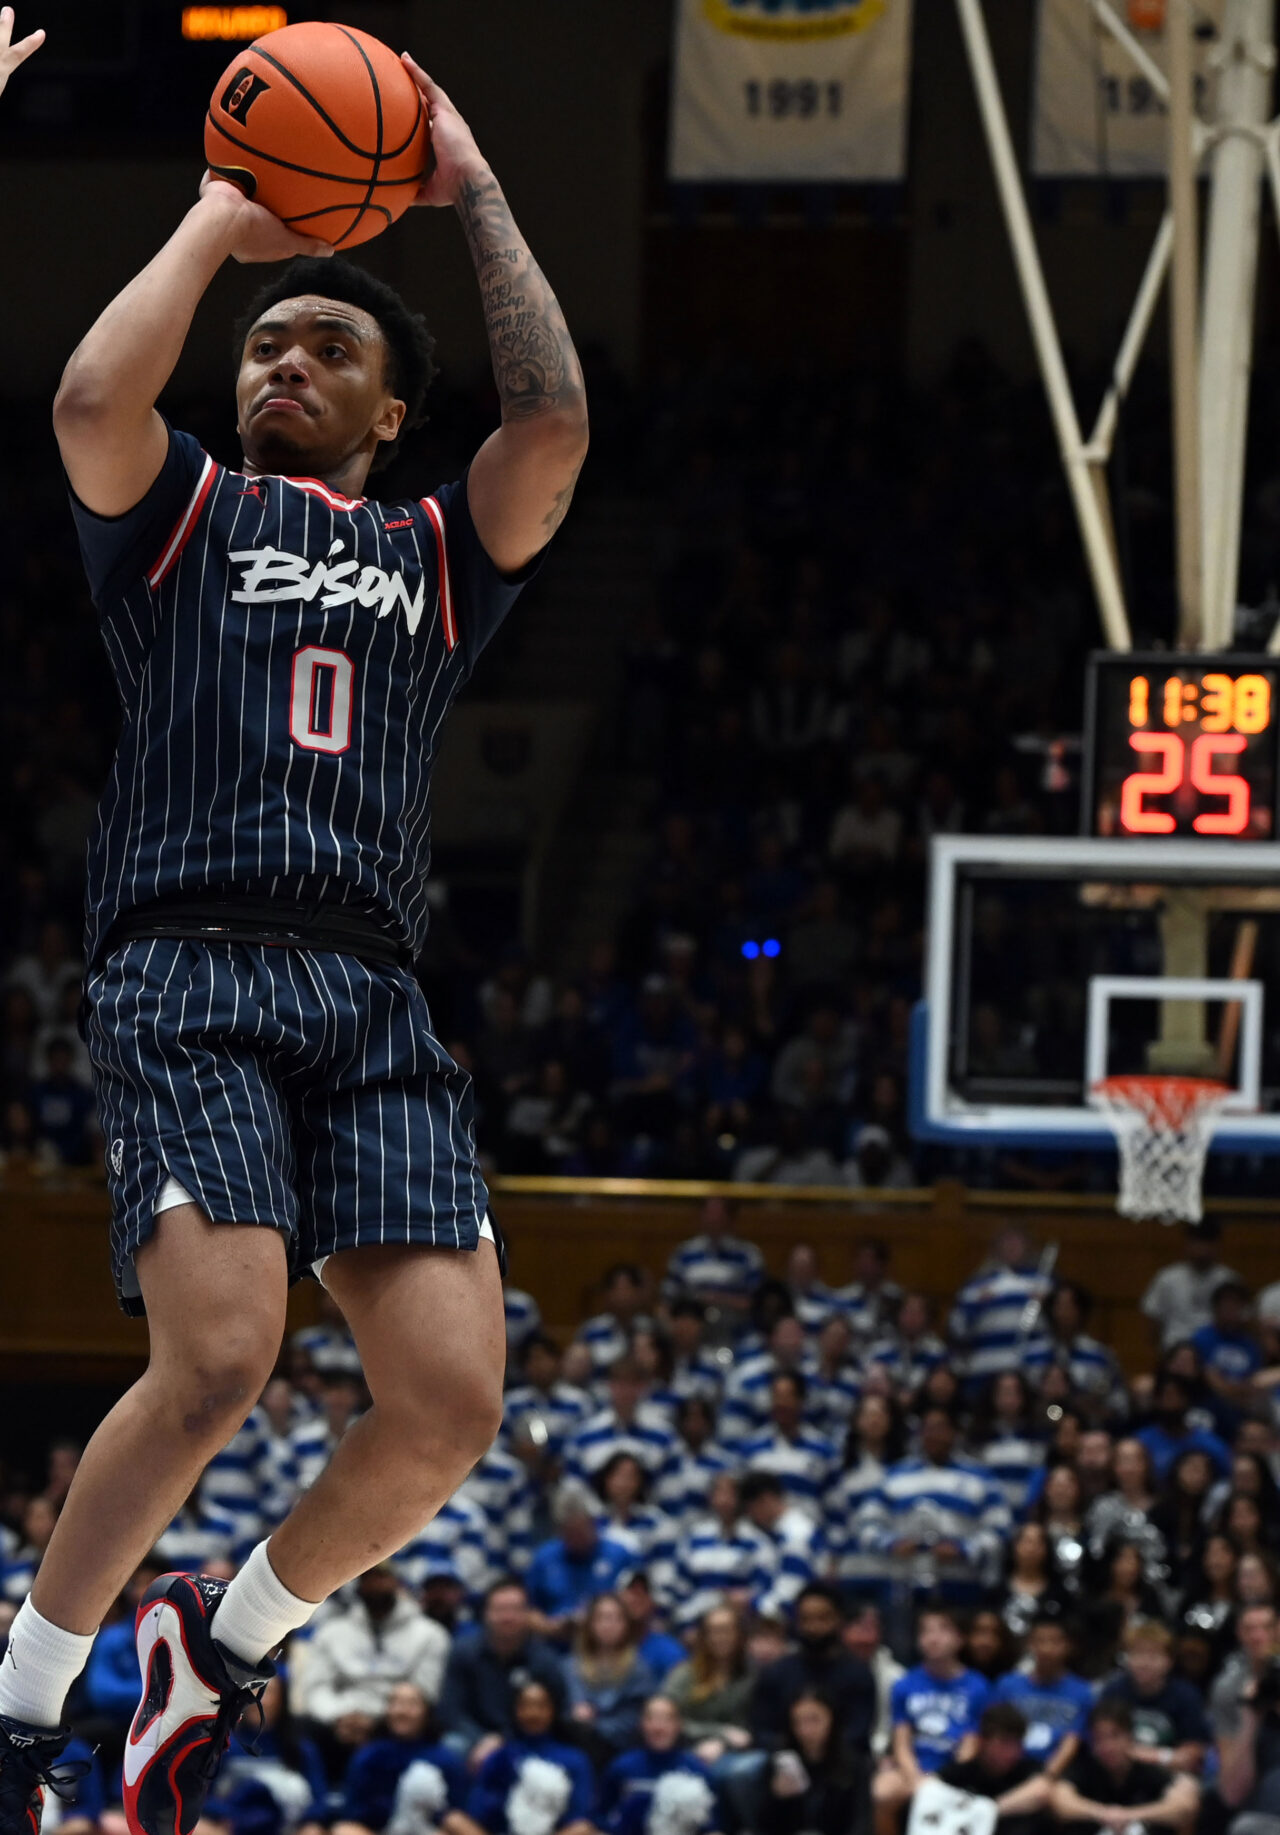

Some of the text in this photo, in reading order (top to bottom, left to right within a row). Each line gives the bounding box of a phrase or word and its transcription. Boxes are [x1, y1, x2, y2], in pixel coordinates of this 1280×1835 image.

[745, 78, 843, 121] 1991
[289, 645, 355, 754] 0
[1129, 673, 1271, 734] 11:38
[1120, 731, 1251, 835] 25
